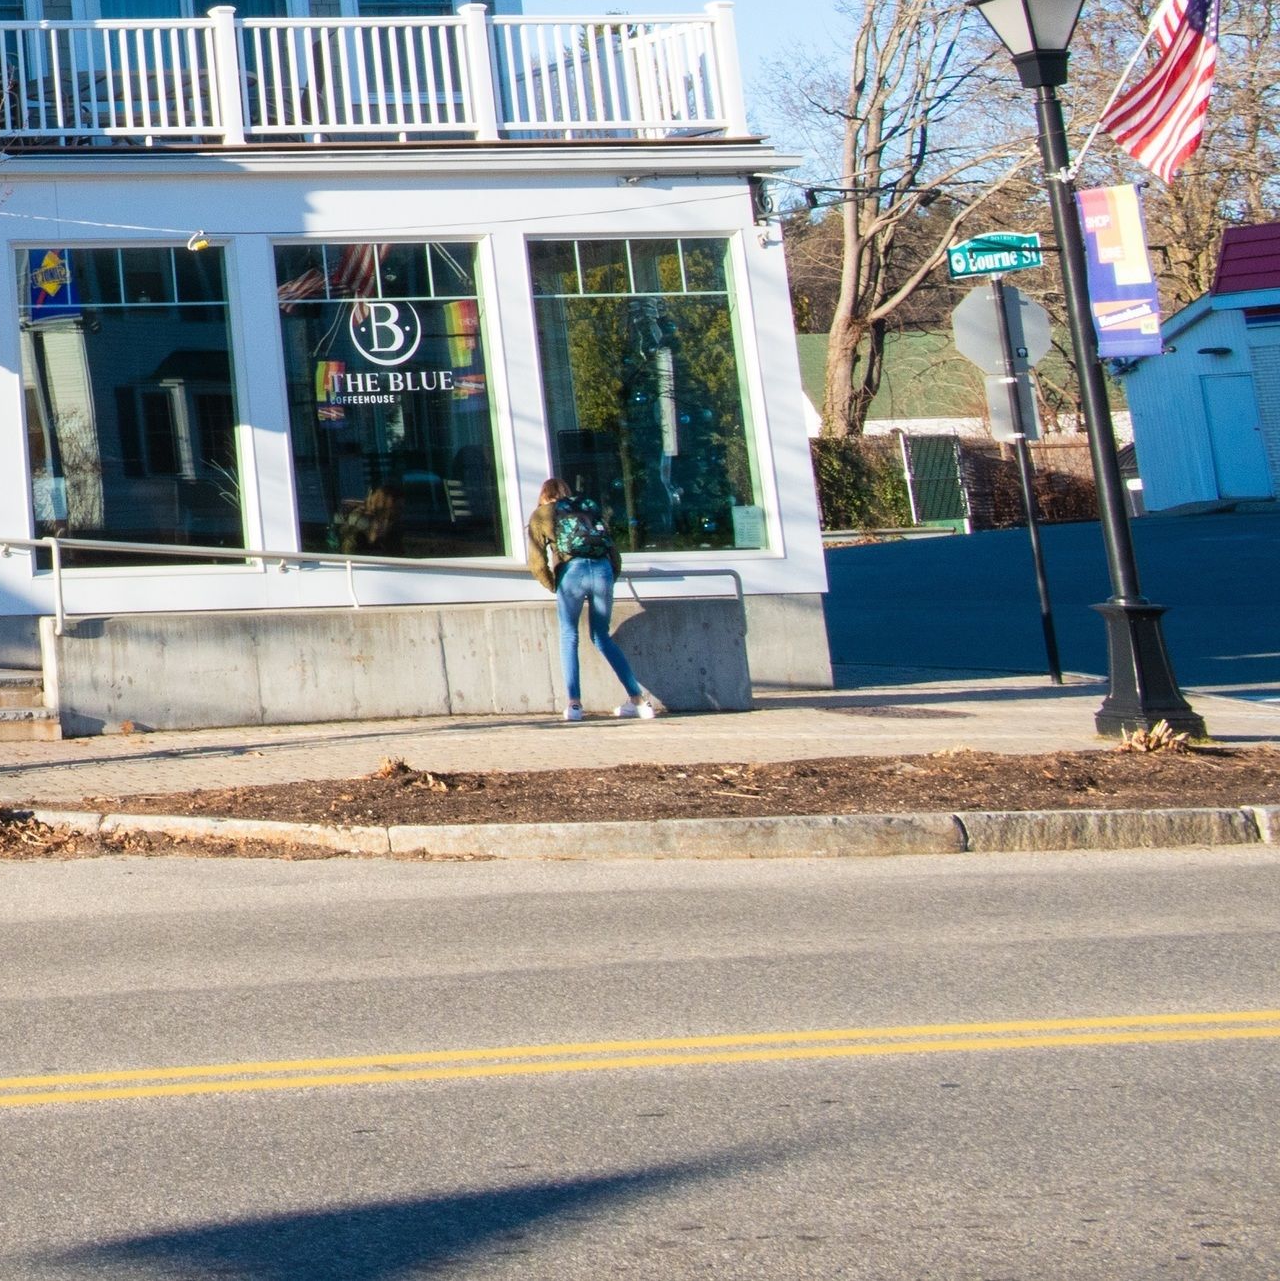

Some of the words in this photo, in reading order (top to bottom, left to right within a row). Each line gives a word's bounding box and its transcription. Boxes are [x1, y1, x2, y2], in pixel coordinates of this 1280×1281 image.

[1085, 215, 1111, 229] SHOP
[330, 372, 380, 393] THE
[389, 371, 454, 391] BLUE
[330, 394, 395, 405] COFFEEHOUSE
